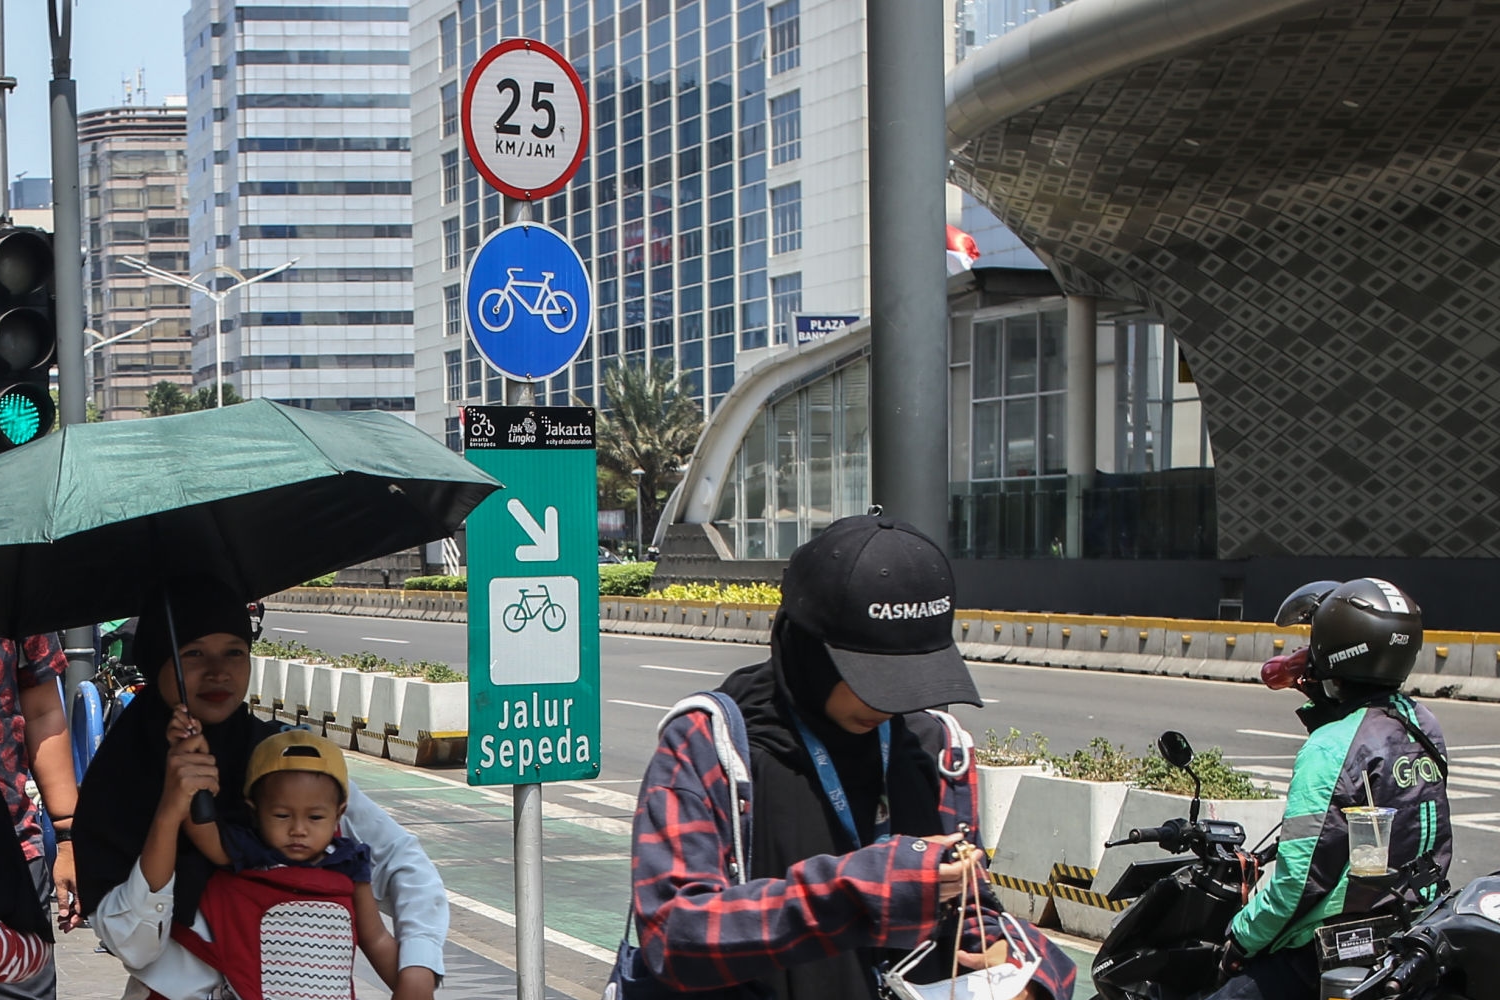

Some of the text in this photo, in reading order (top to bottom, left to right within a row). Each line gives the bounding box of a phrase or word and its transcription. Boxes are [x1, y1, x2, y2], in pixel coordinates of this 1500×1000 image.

[496, 77, 556, 138] 25
[495, 139, 555, 158] KM/JAM
[810, 319, 846, 331] PLAZA
[508, 423, 523, 434] Jak
[546, 422, 592, 436] Jakarta
[508, 433, 536, 445] Lingko
[480, 728, 590, 776] Sepeda
[1393, 755, 1446, 788] Gra
